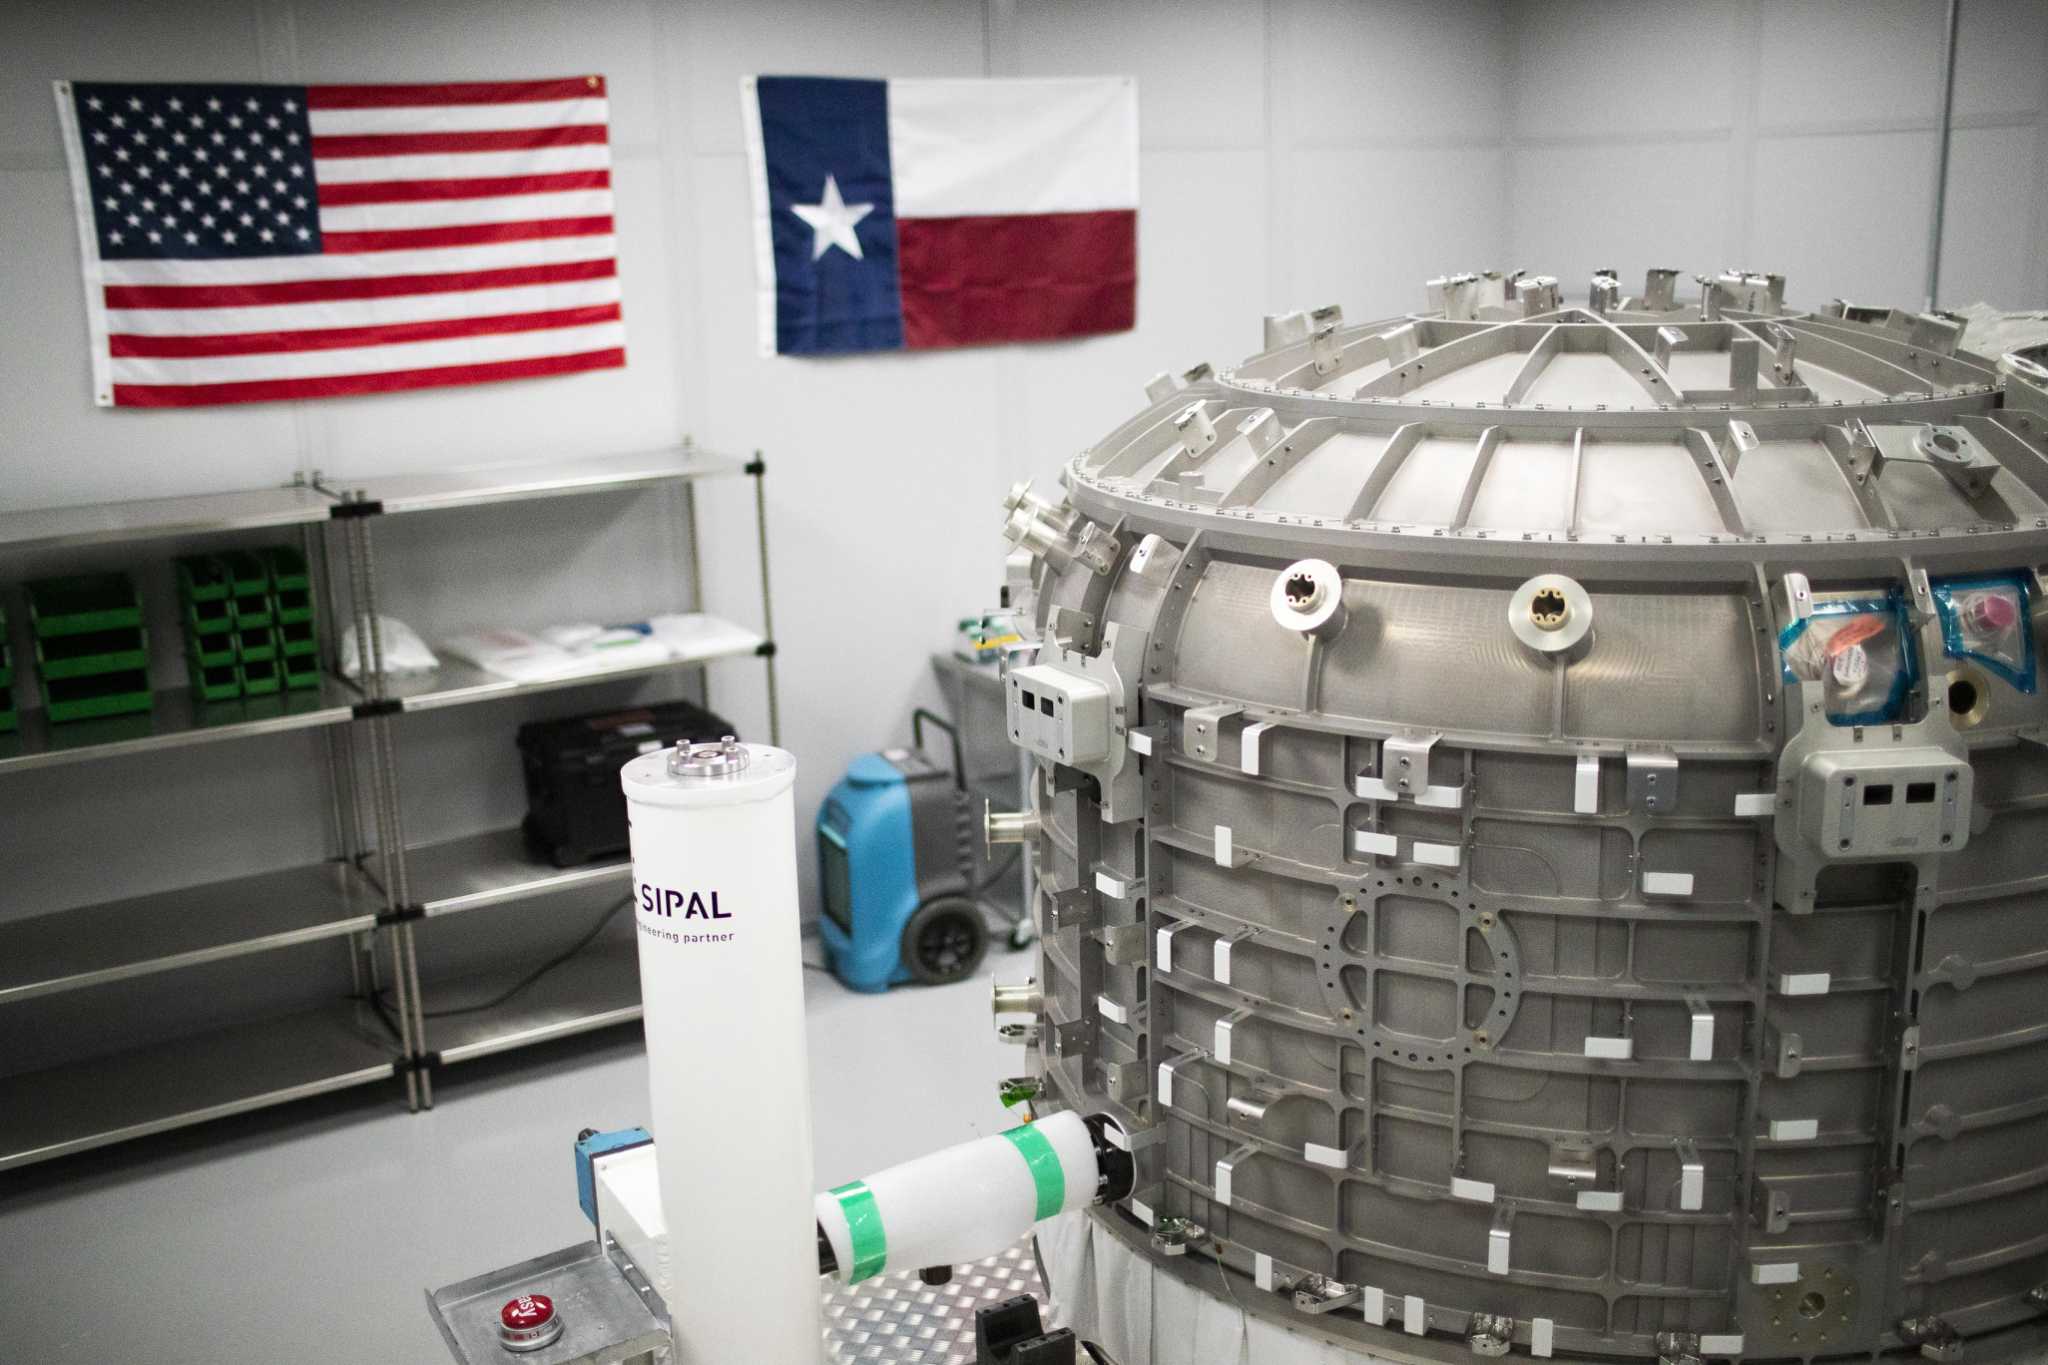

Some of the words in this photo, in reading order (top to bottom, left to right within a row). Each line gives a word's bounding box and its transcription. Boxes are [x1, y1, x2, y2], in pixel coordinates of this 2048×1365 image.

[641, 884, 732, 919] SIPAL
[683, 933, 735, 944] partner
[518, 1295, 537, 1317] asy
